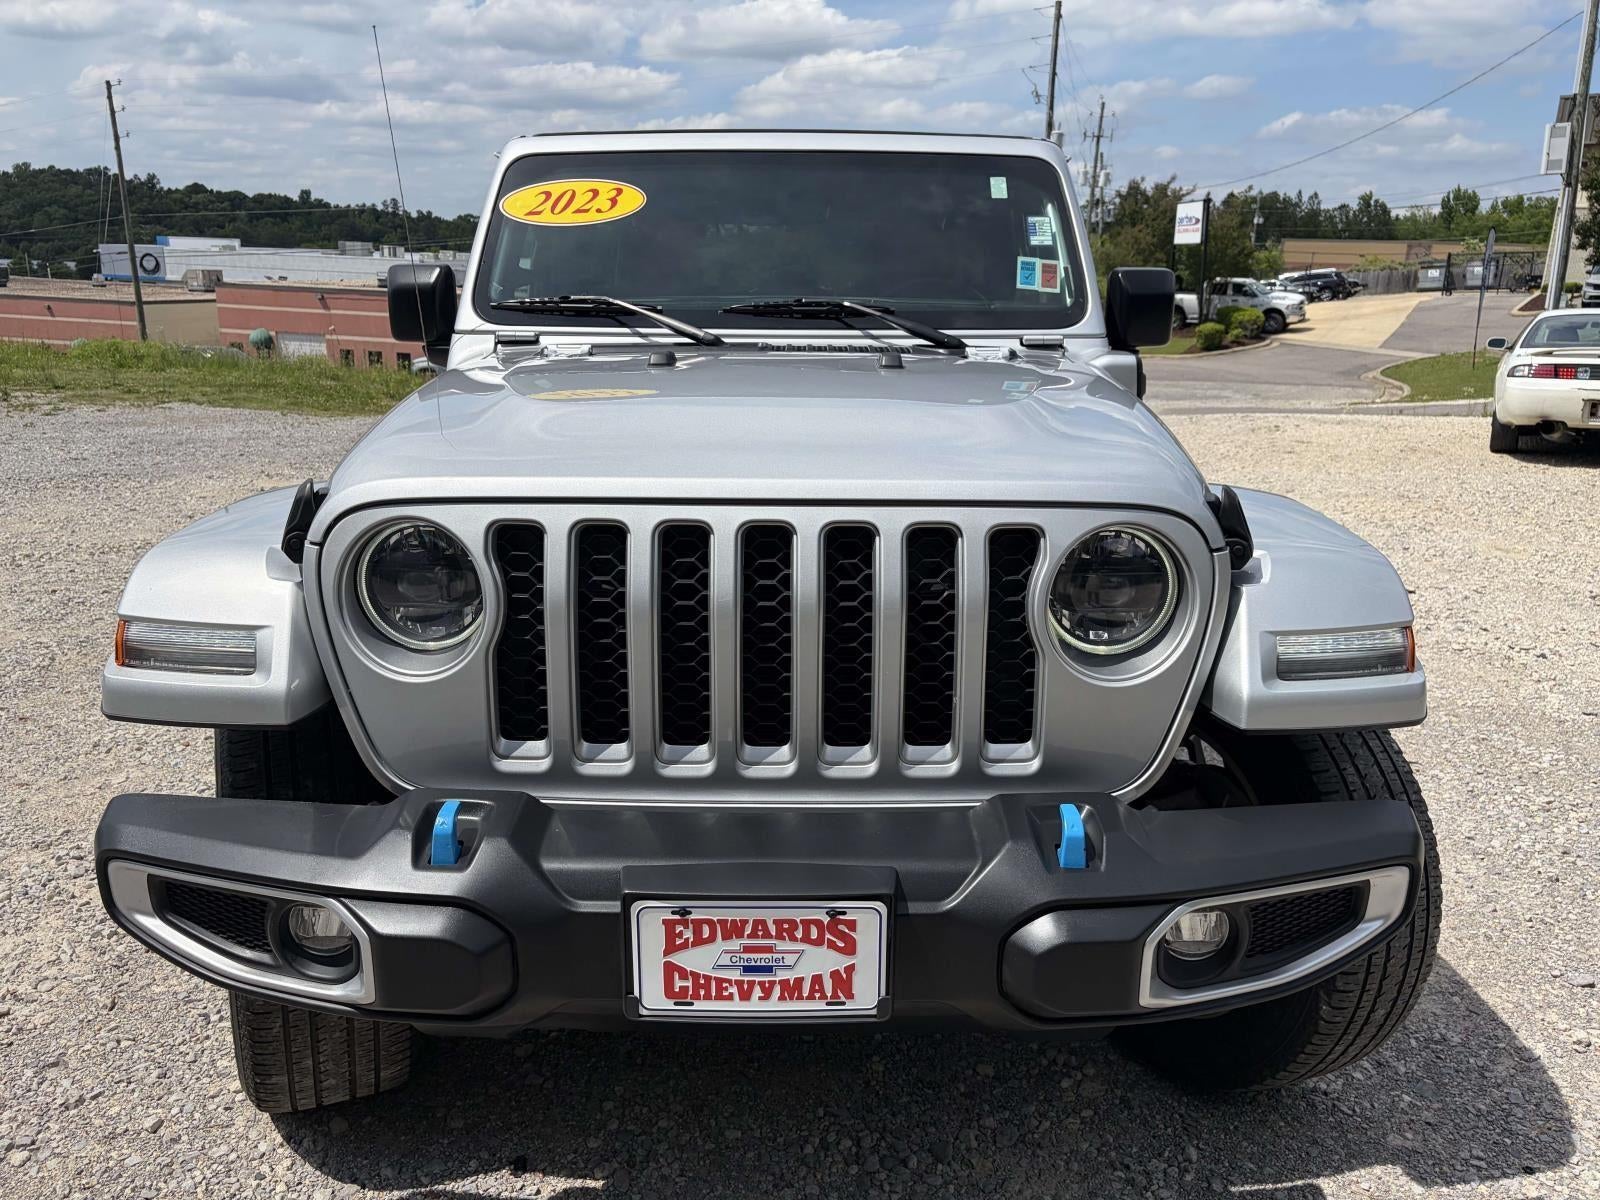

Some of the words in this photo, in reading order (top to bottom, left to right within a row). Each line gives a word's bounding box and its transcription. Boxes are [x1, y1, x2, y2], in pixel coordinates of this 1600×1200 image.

[524, 187, 624, 216] 2023
[662, 917, 857, 958] EDWARDS
[729, 954, 786, 965] Chevrolet
[662, 959, 857, 1001] CHEVYMAN
